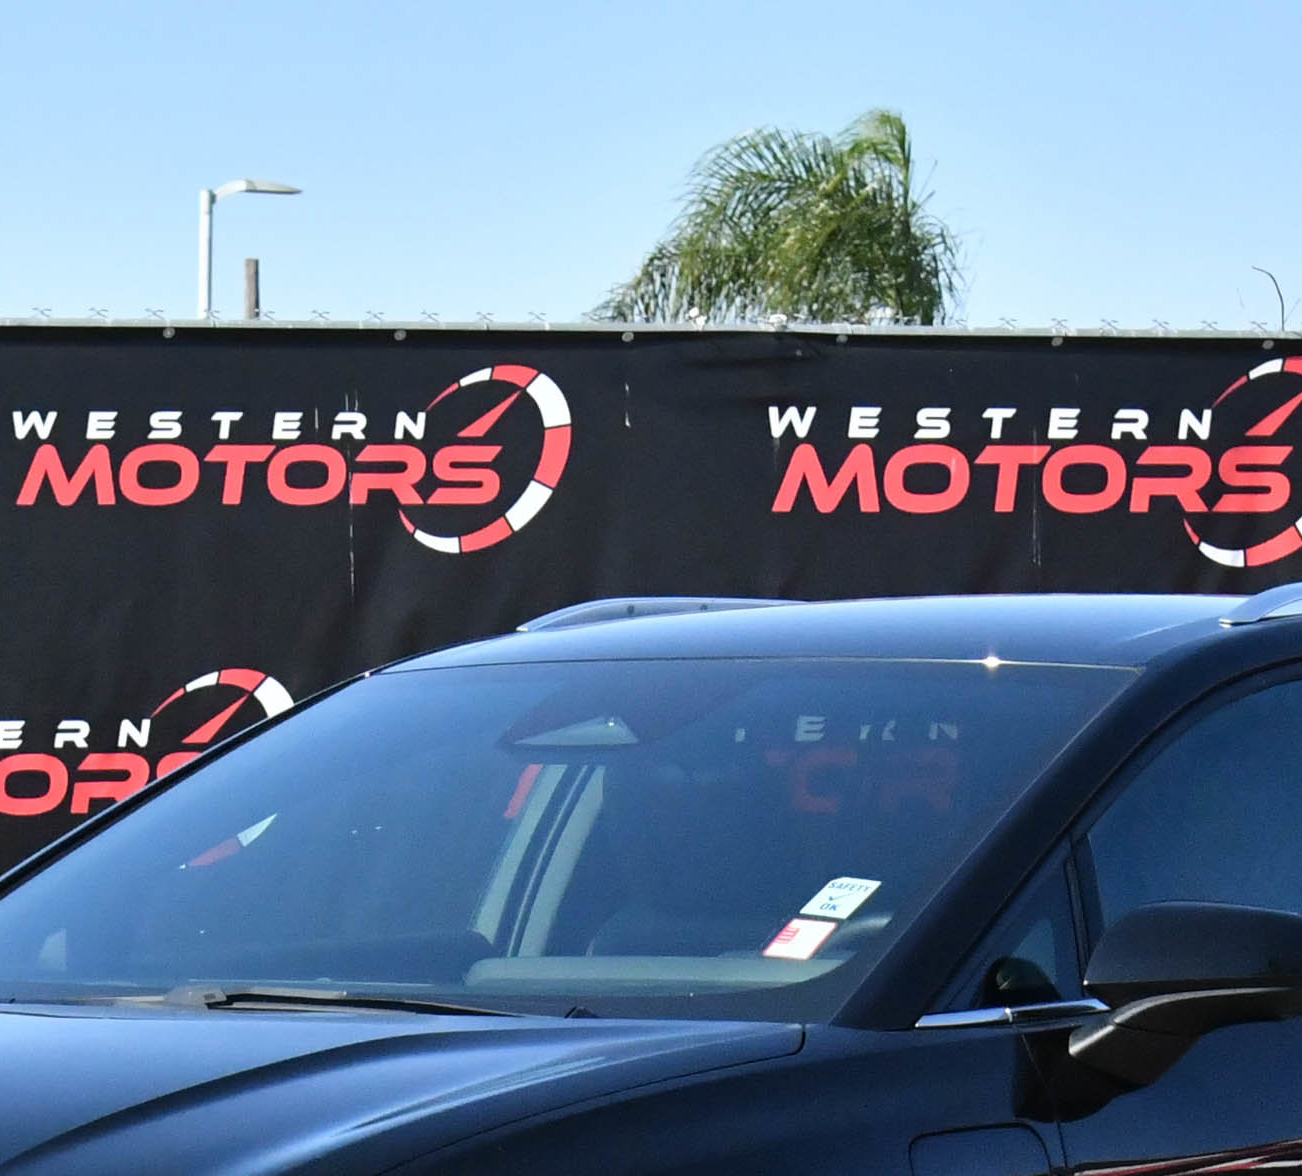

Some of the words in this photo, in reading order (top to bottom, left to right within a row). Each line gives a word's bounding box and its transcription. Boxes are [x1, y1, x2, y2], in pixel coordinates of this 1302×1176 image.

[12, 410, 428, 441] WESTERN
[768, 405, 1214, 441] WESTERN
[15, 443, 503, 507] MOTORS
[771, 442, 1294, 514] MOTORS
[828, 882, 871, 893] SAFETY
[819, 902, 838, 912] OK
